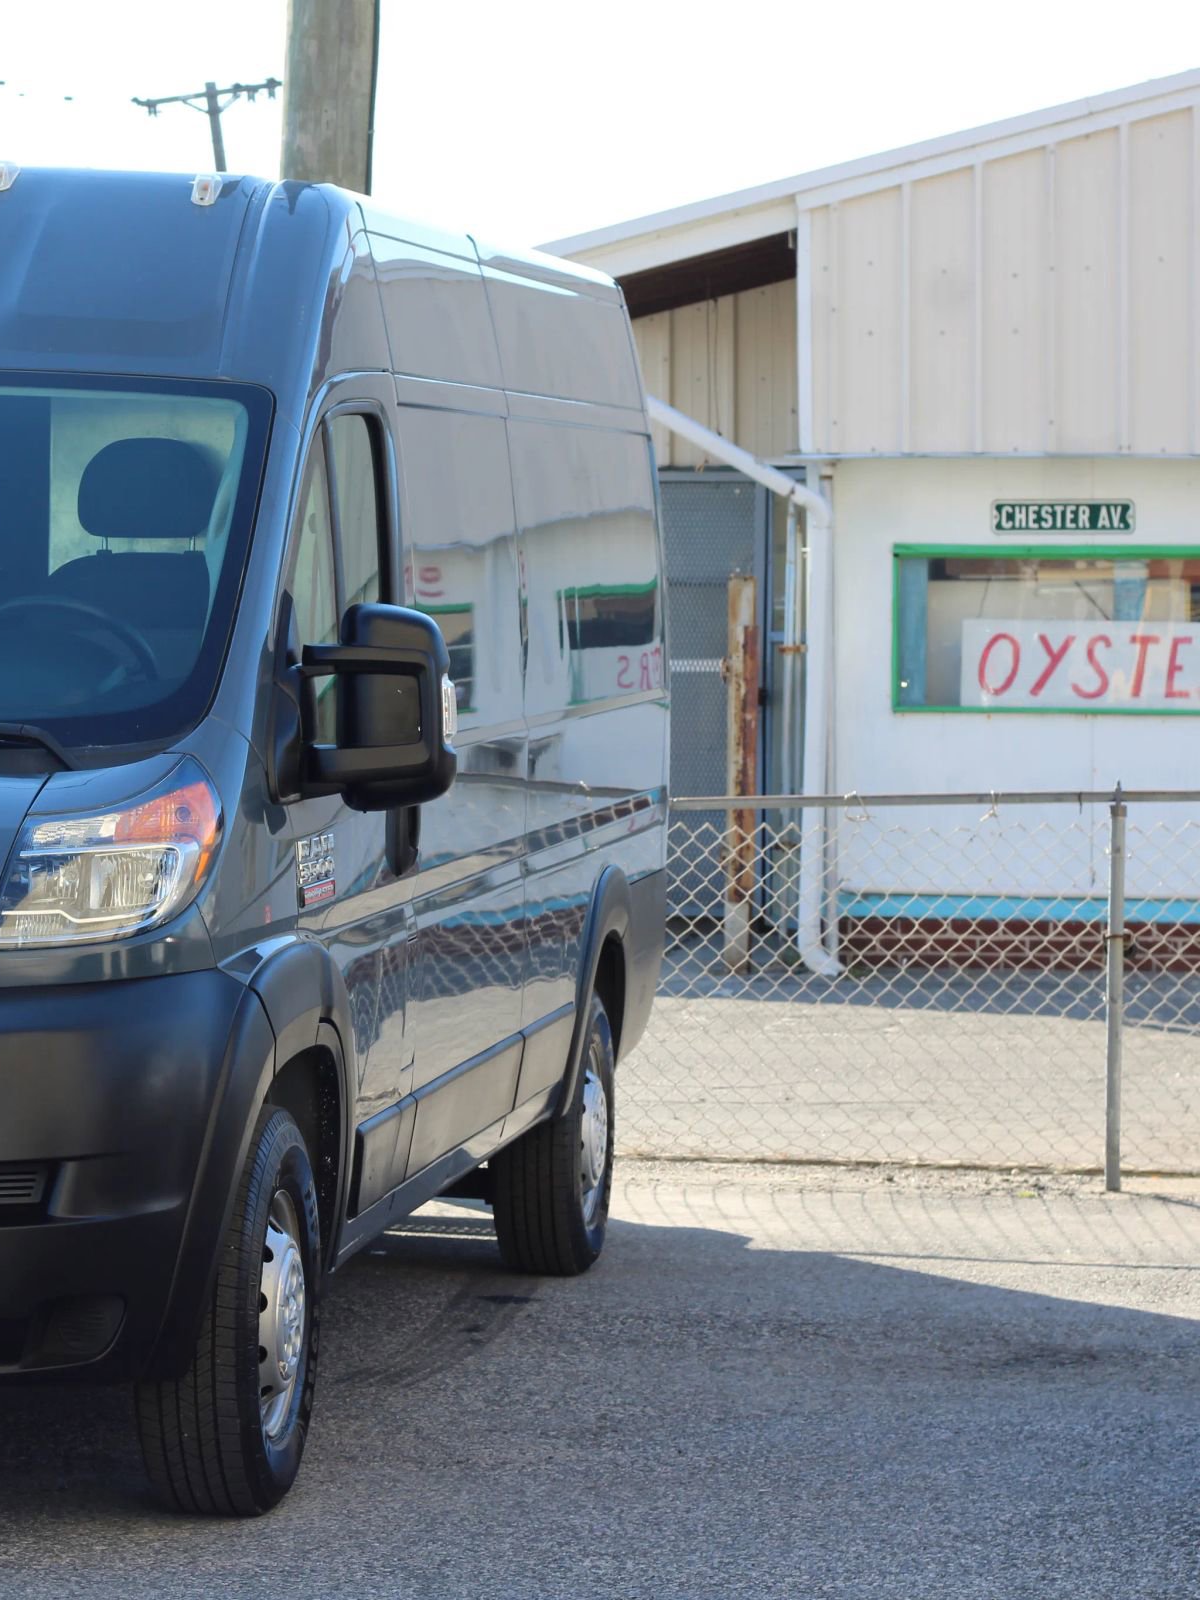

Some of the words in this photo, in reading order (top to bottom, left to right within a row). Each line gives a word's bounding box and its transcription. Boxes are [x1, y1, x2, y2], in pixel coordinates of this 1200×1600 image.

[1001, 505, 1090, 530] CHESTER
[1099, 504, 1125, 529] AV.
[977, 633, 1200, 699] OYSTE
